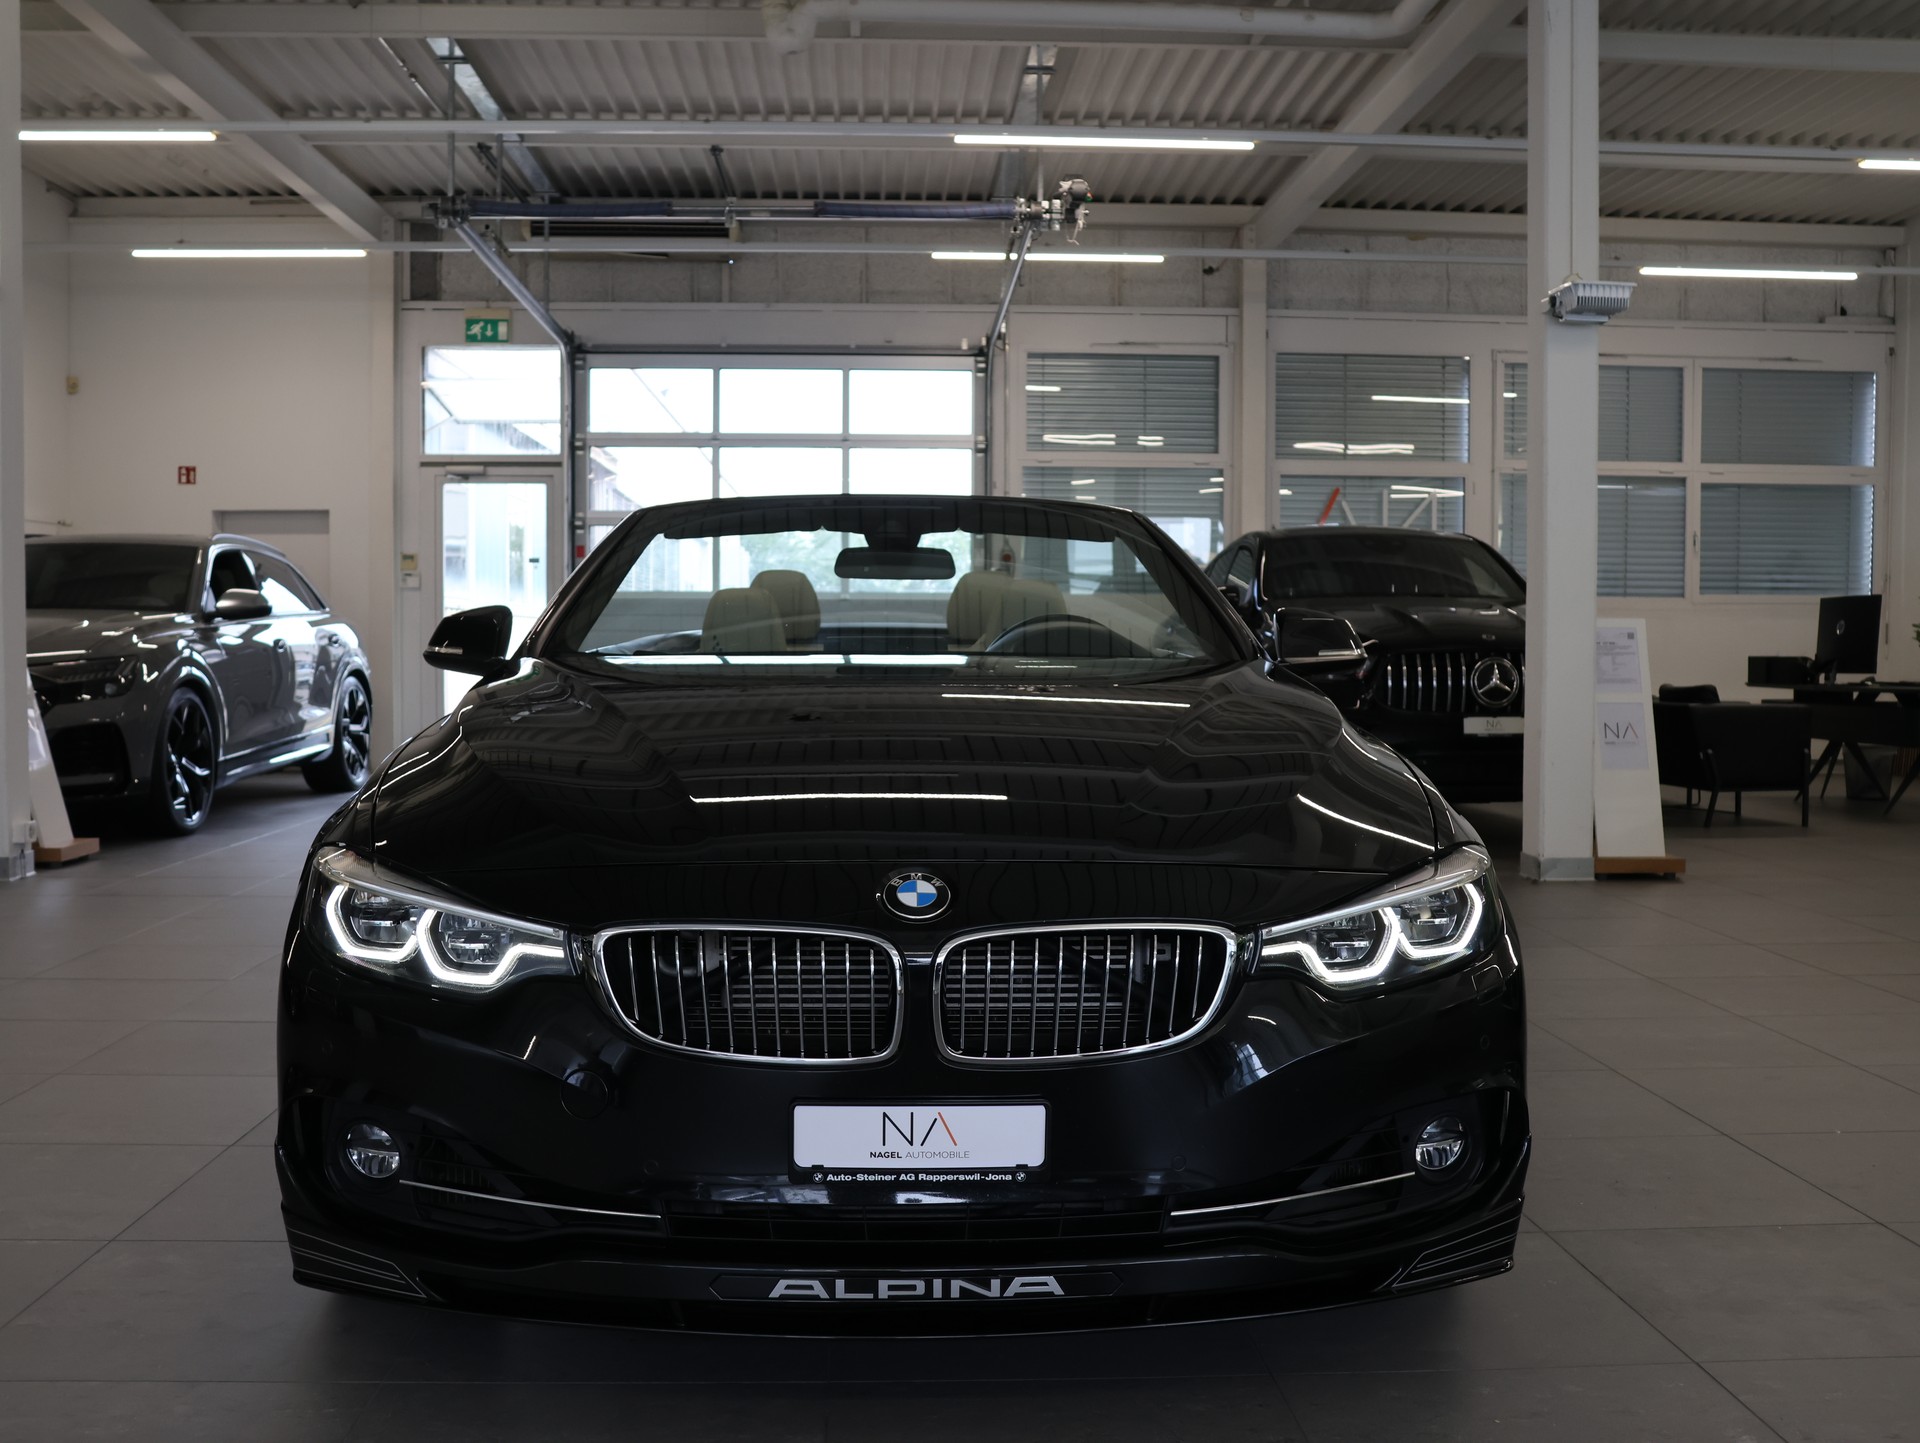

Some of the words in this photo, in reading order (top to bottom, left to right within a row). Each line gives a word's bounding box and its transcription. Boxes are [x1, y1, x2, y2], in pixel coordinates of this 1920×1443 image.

[1604, 722, 1639, 739] NA
[891, 873, 943, 886] BMW
[882, 1111, 957, 1147] NA
[869, 1150, 903, 1159] NAGEL
[905, 1150, 970, 1159] AUTOMOBILE
[826, 1173, 897, 1181] Auto-Steiner
[899, 1173, 915, 1181] AG
[918, 1173, 1012, 1183] Rapperswil-Jona
[768, 1276, 1065, 1298] ALPINA
